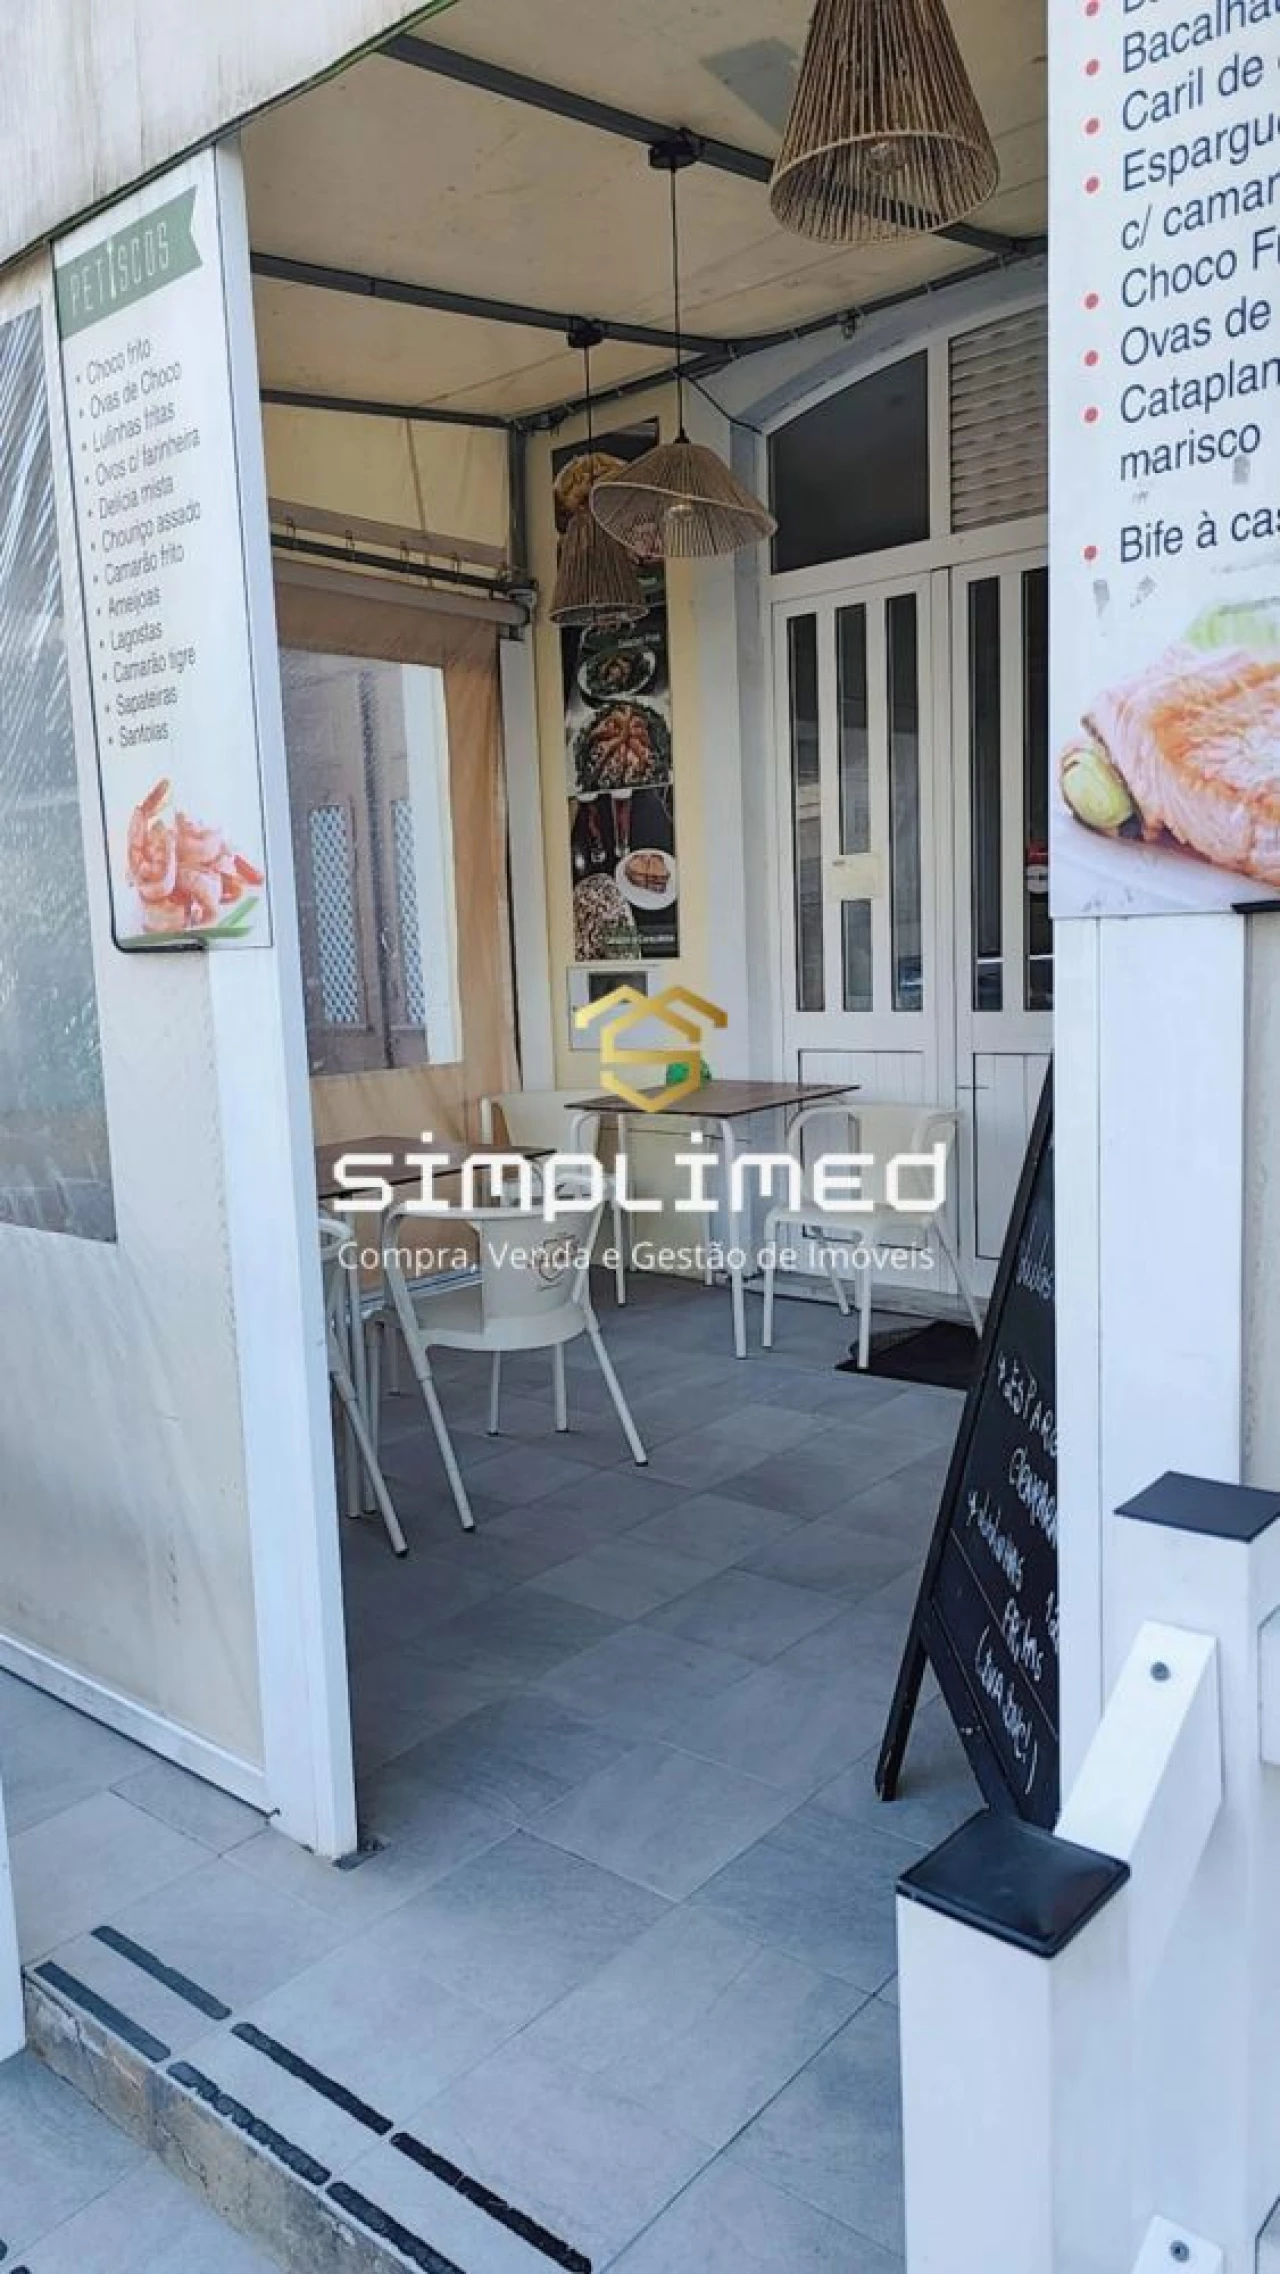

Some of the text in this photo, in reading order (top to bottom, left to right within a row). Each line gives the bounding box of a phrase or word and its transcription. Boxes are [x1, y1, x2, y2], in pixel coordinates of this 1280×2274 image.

[1122, 53, 1264, 131] Caril de
[1123, 113, 1280, 191] Espargu
[1122, 203, 1152, 250] c/
[69, 221, 170, 317] PETISCOS
[1122, 225, 1280, 307] Choco F
[1120, 296, 1271, 366] Ovas de
[87, 338, 151, 384] Choco frito
[91, 361, 182, 418] Ovas de Choco
[1120, 356, 1280, 423] Cataplan
[93, 402, 175, 453] Lulinhas fritas
[1120, 423, 1261, 481] marisco
[96, 461, 126, 486] Ovos
[141, 475, 174, 502] mista
[157, 499, 201, 533] assado
[1120, 519, 1183, 563] Bife
[1196, 509, 1217, 549] à
[105, 542, 185, 585] Camarão frito
[111, 621, 163, 653] Lagostas
[113, 645, 196, 683] Camarão tigre
[115, 685, 178, 717] Sapateiras
